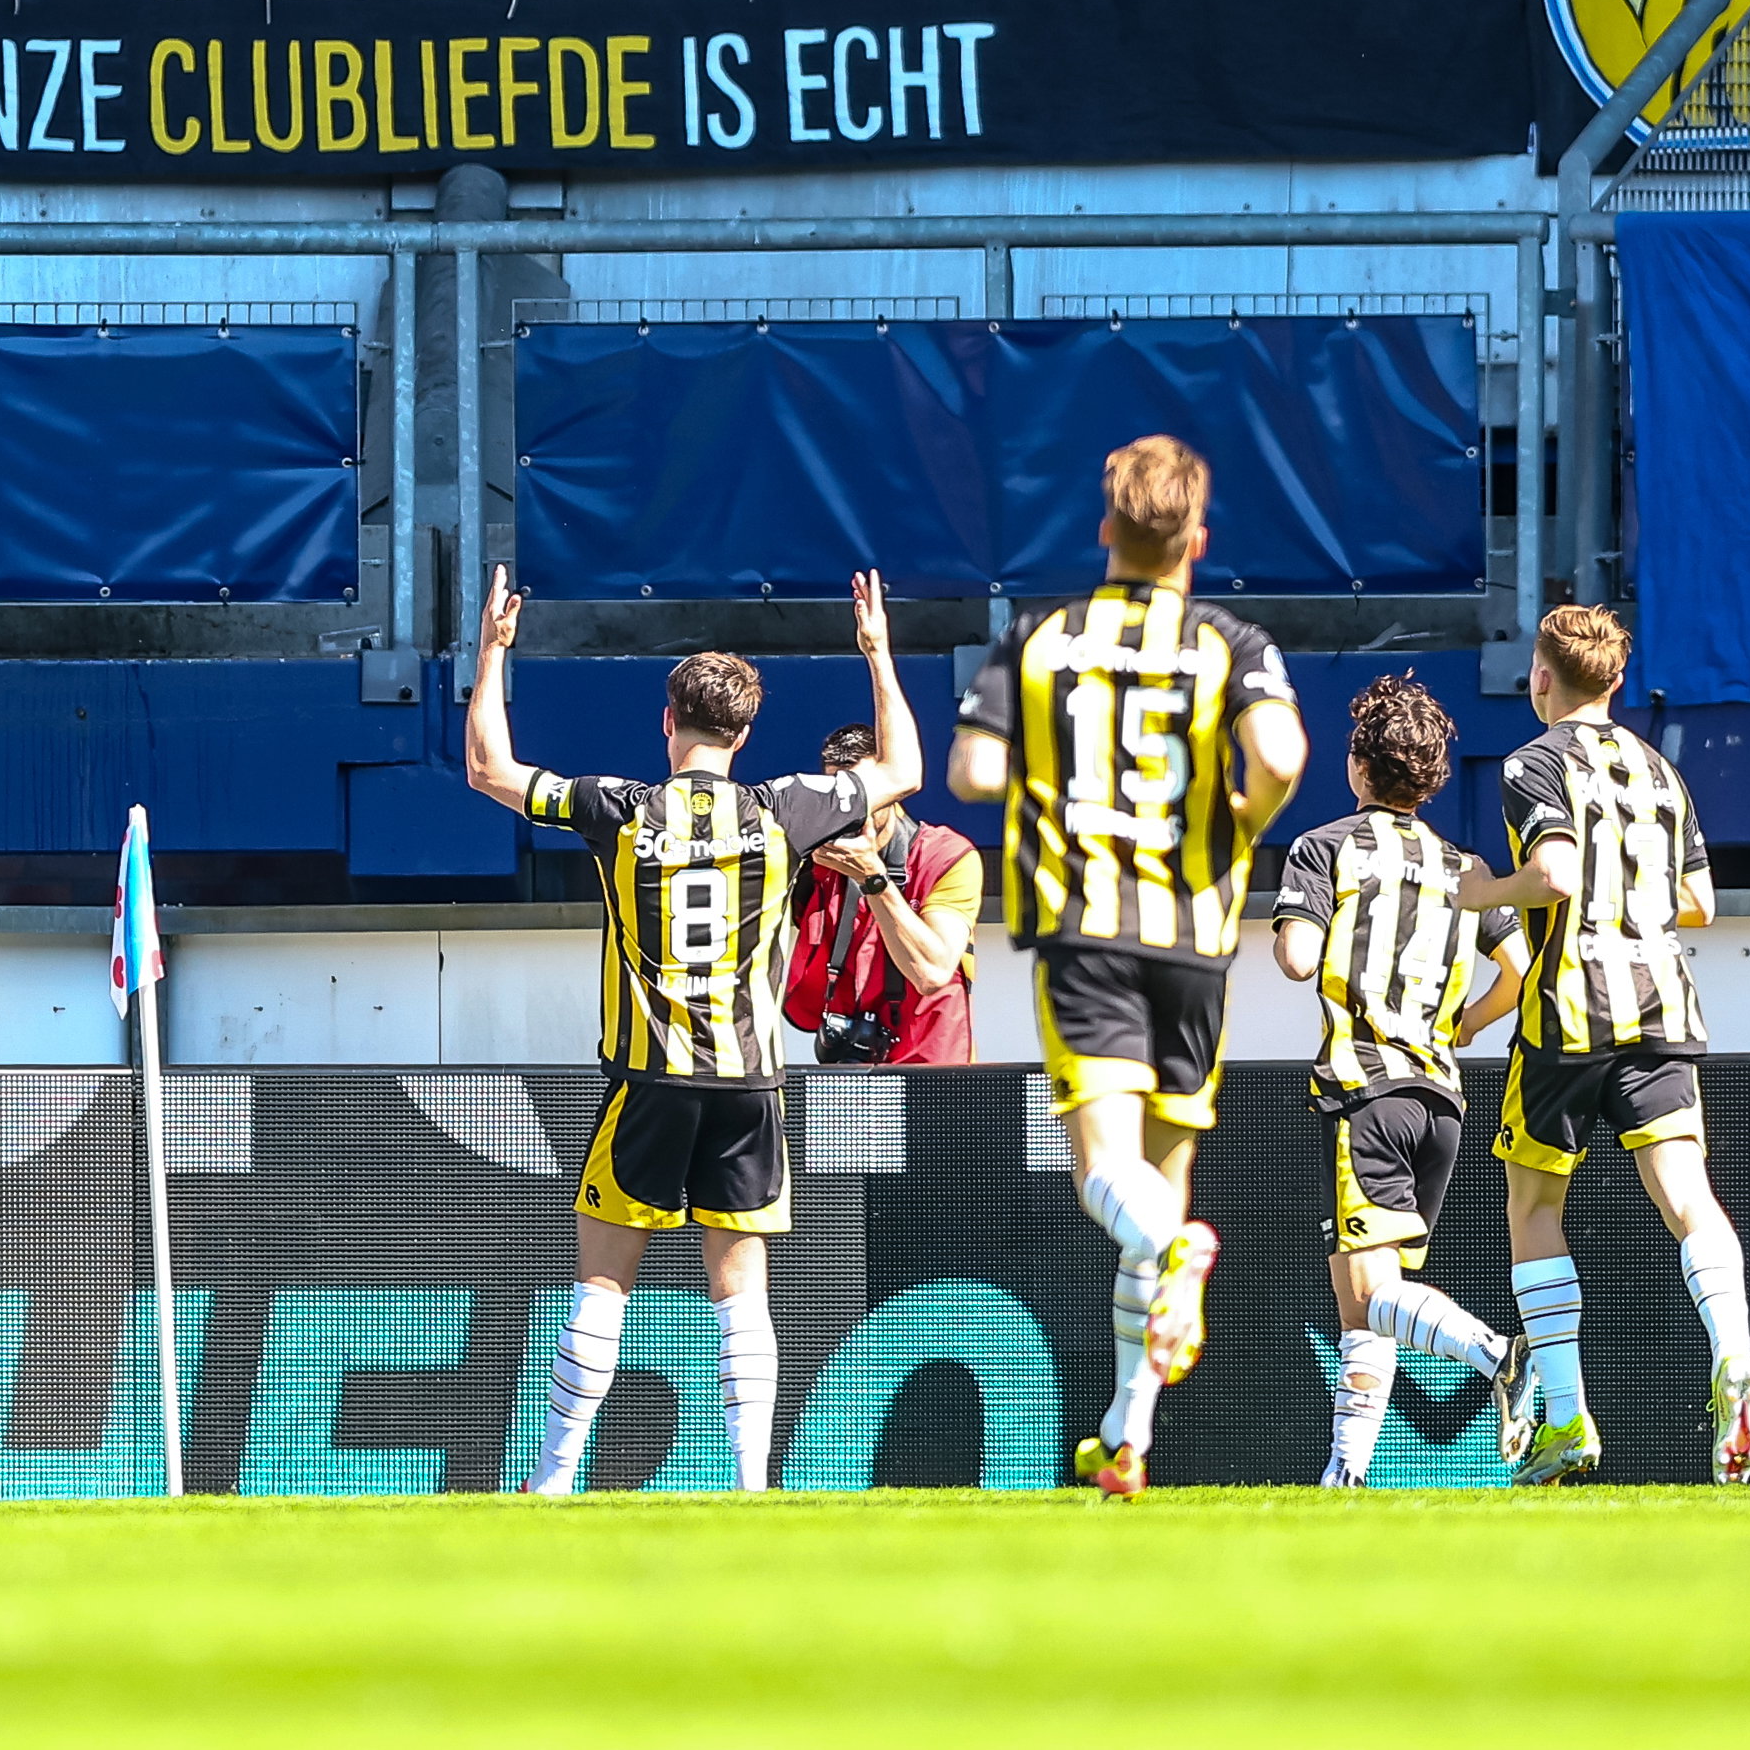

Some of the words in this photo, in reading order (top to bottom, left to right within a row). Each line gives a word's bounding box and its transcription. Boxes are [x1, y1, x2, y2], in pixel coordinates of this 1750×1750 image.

[148, 34, 658, 155] CLUBLIEFDE
[681, 32, 757, 151] IS
[783, 21, 996, 143] ECHT
[1066, 684, 1189, 804] 15
[669, 867, 729, 964] 8
[1359, 893, 1454, 1007] 14
